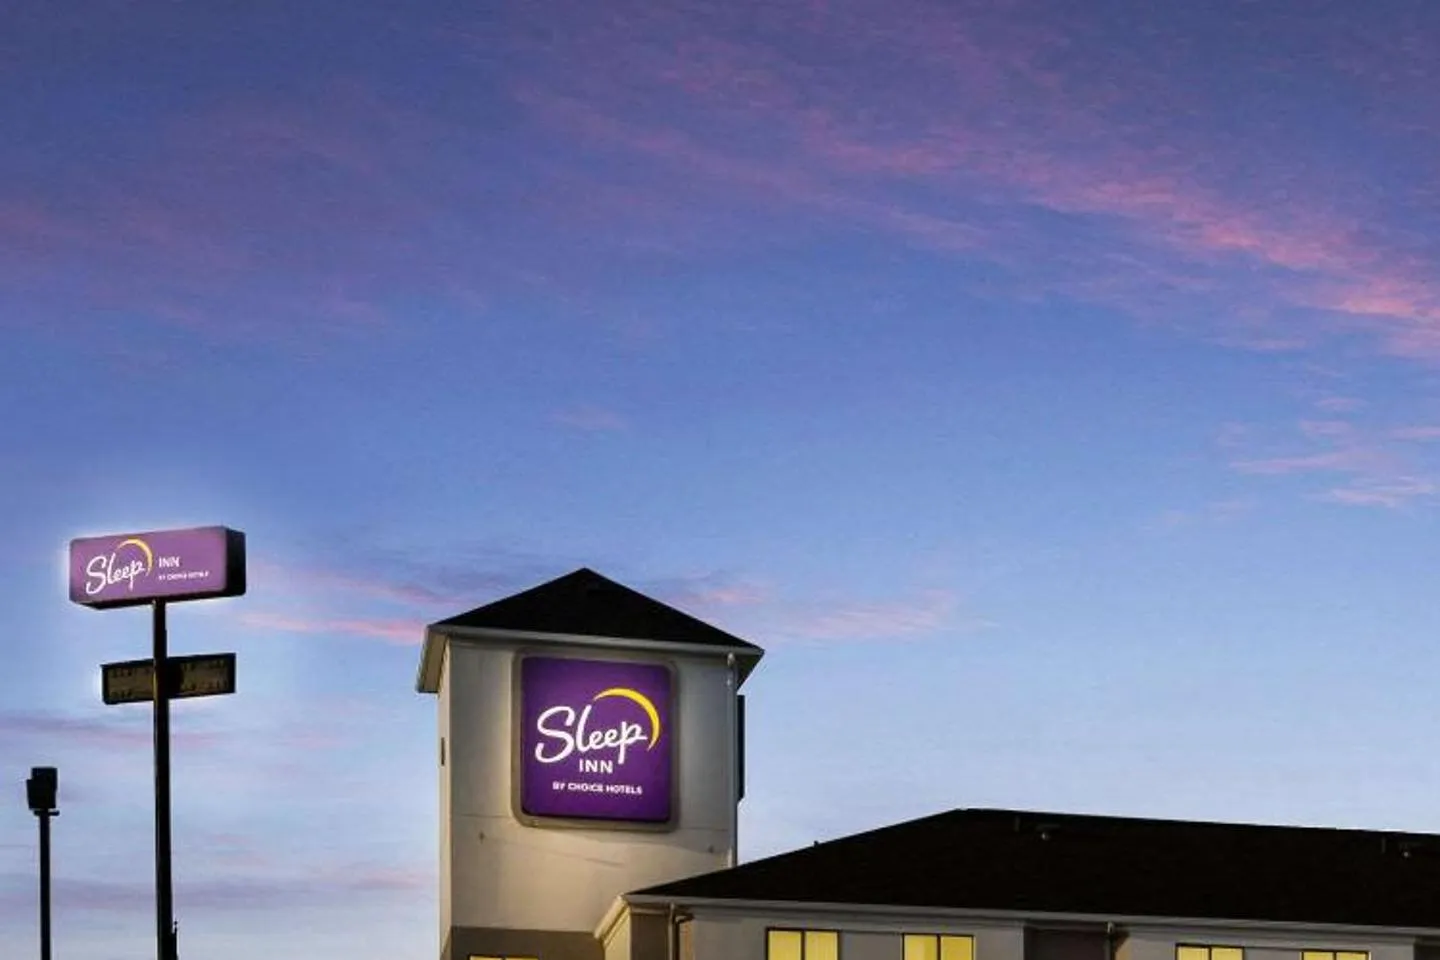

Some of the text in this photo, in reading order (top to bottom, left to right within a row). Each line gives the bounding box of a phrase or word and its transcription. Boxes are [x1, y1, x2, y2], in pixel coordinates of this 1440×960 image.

[85, 552, 180, 595] Sleep INN
[534, 704, 648, 765] Sleep
[579, 758, 613, 773] INN
[552, 781, 642, 795] BY CHOICE HOTELS
